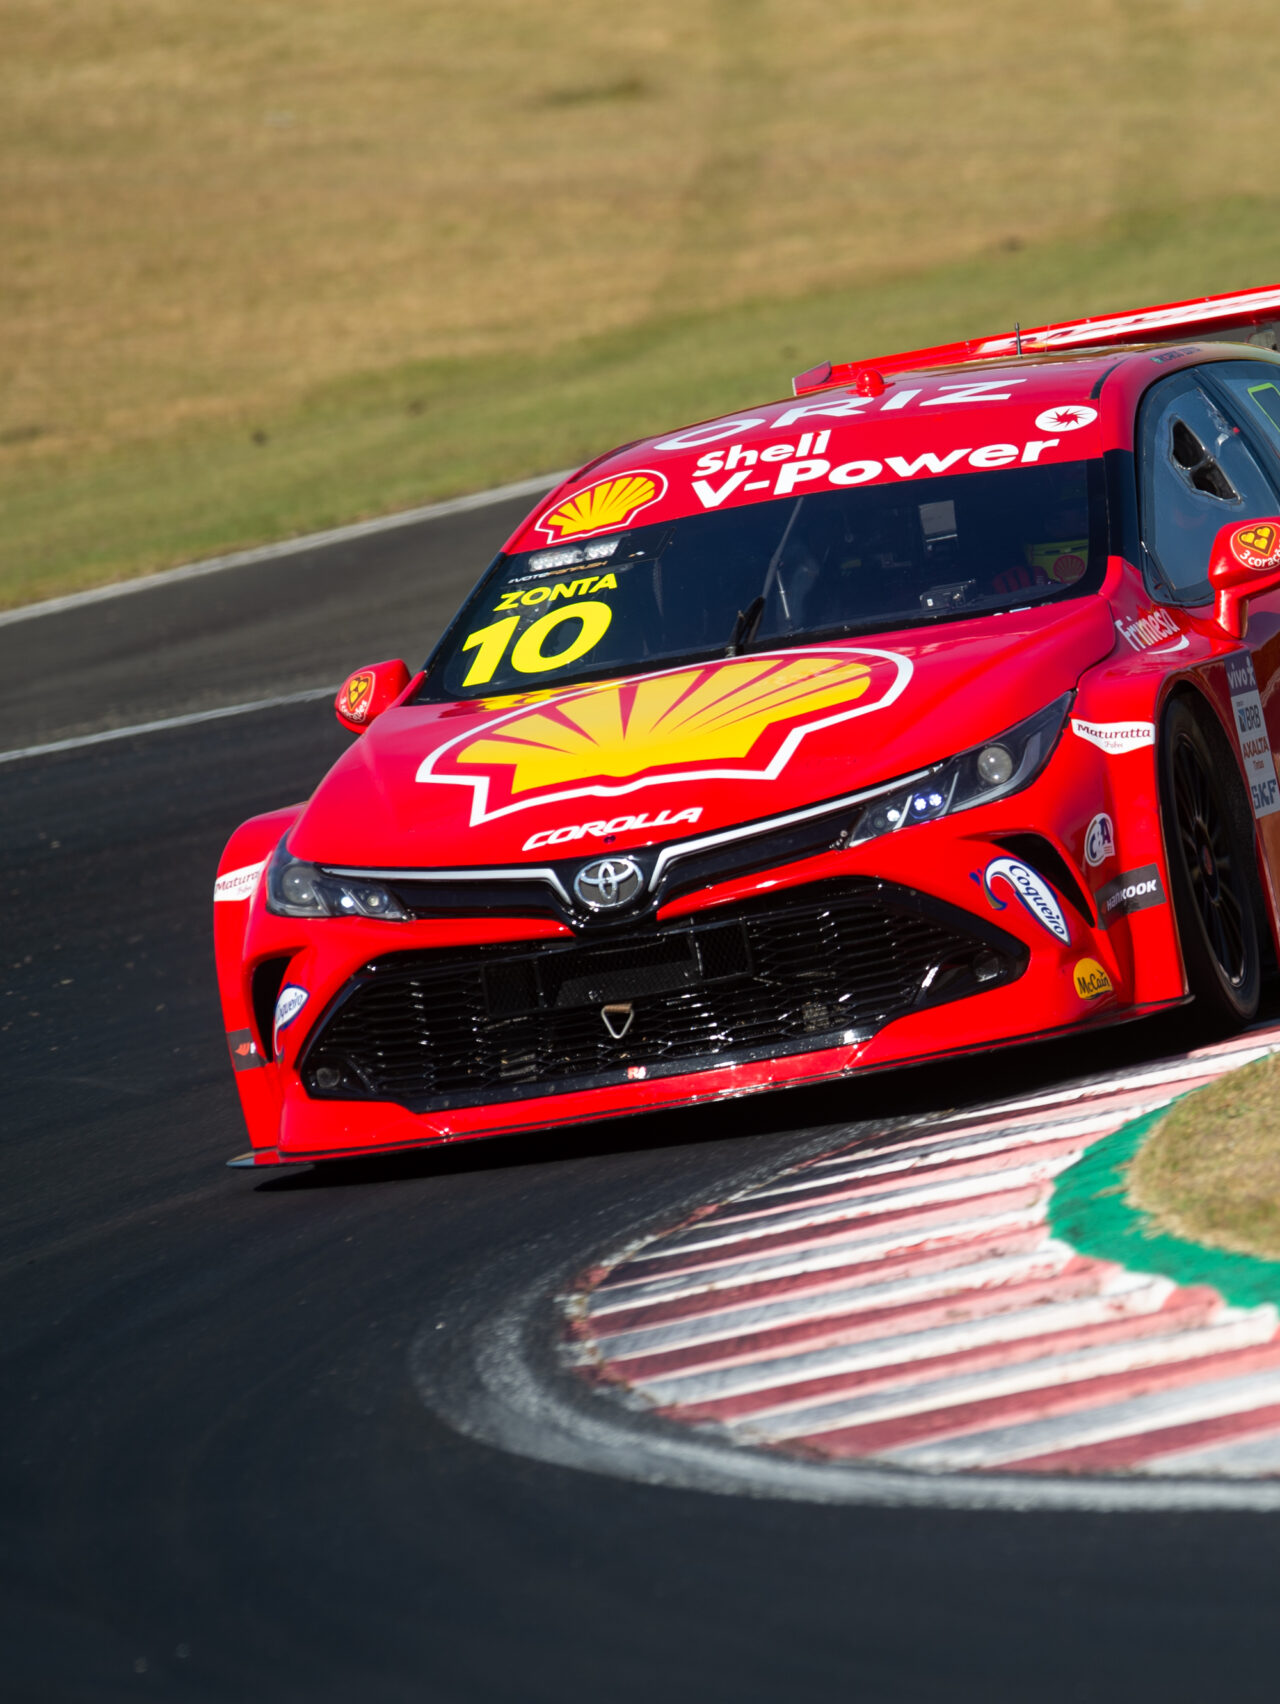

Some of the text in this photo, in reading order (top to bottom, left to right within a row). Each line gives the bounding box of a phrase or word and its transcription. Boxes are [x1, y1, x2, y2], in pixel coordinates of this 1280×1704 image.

[654, 379, 1026, 451] ORIZ
[693, 430, 831, 477] Shell
[692, 438, 1059, 508] V-Power
[1240, 550, 1251, 560] 3
[493, 573, 617, 611] ZONTA
[462, 601, 613, 687] 10
[1114, 608, 1180, 652] Frimesa
[1227, 661, 1249, 690] vivo
[1077, 723, 1152, 739] Maturatta
[1245, 704, 1262, 730] BRB
[1242, 735, 1270, 760] AXALTA
[1251, 779, 1277, 809] SKF
[522, 806, 703, 851] COROLLA
[1009, 864, 1065, 935] Coqueiro
[1077, 973, 1110, 995] McCain
